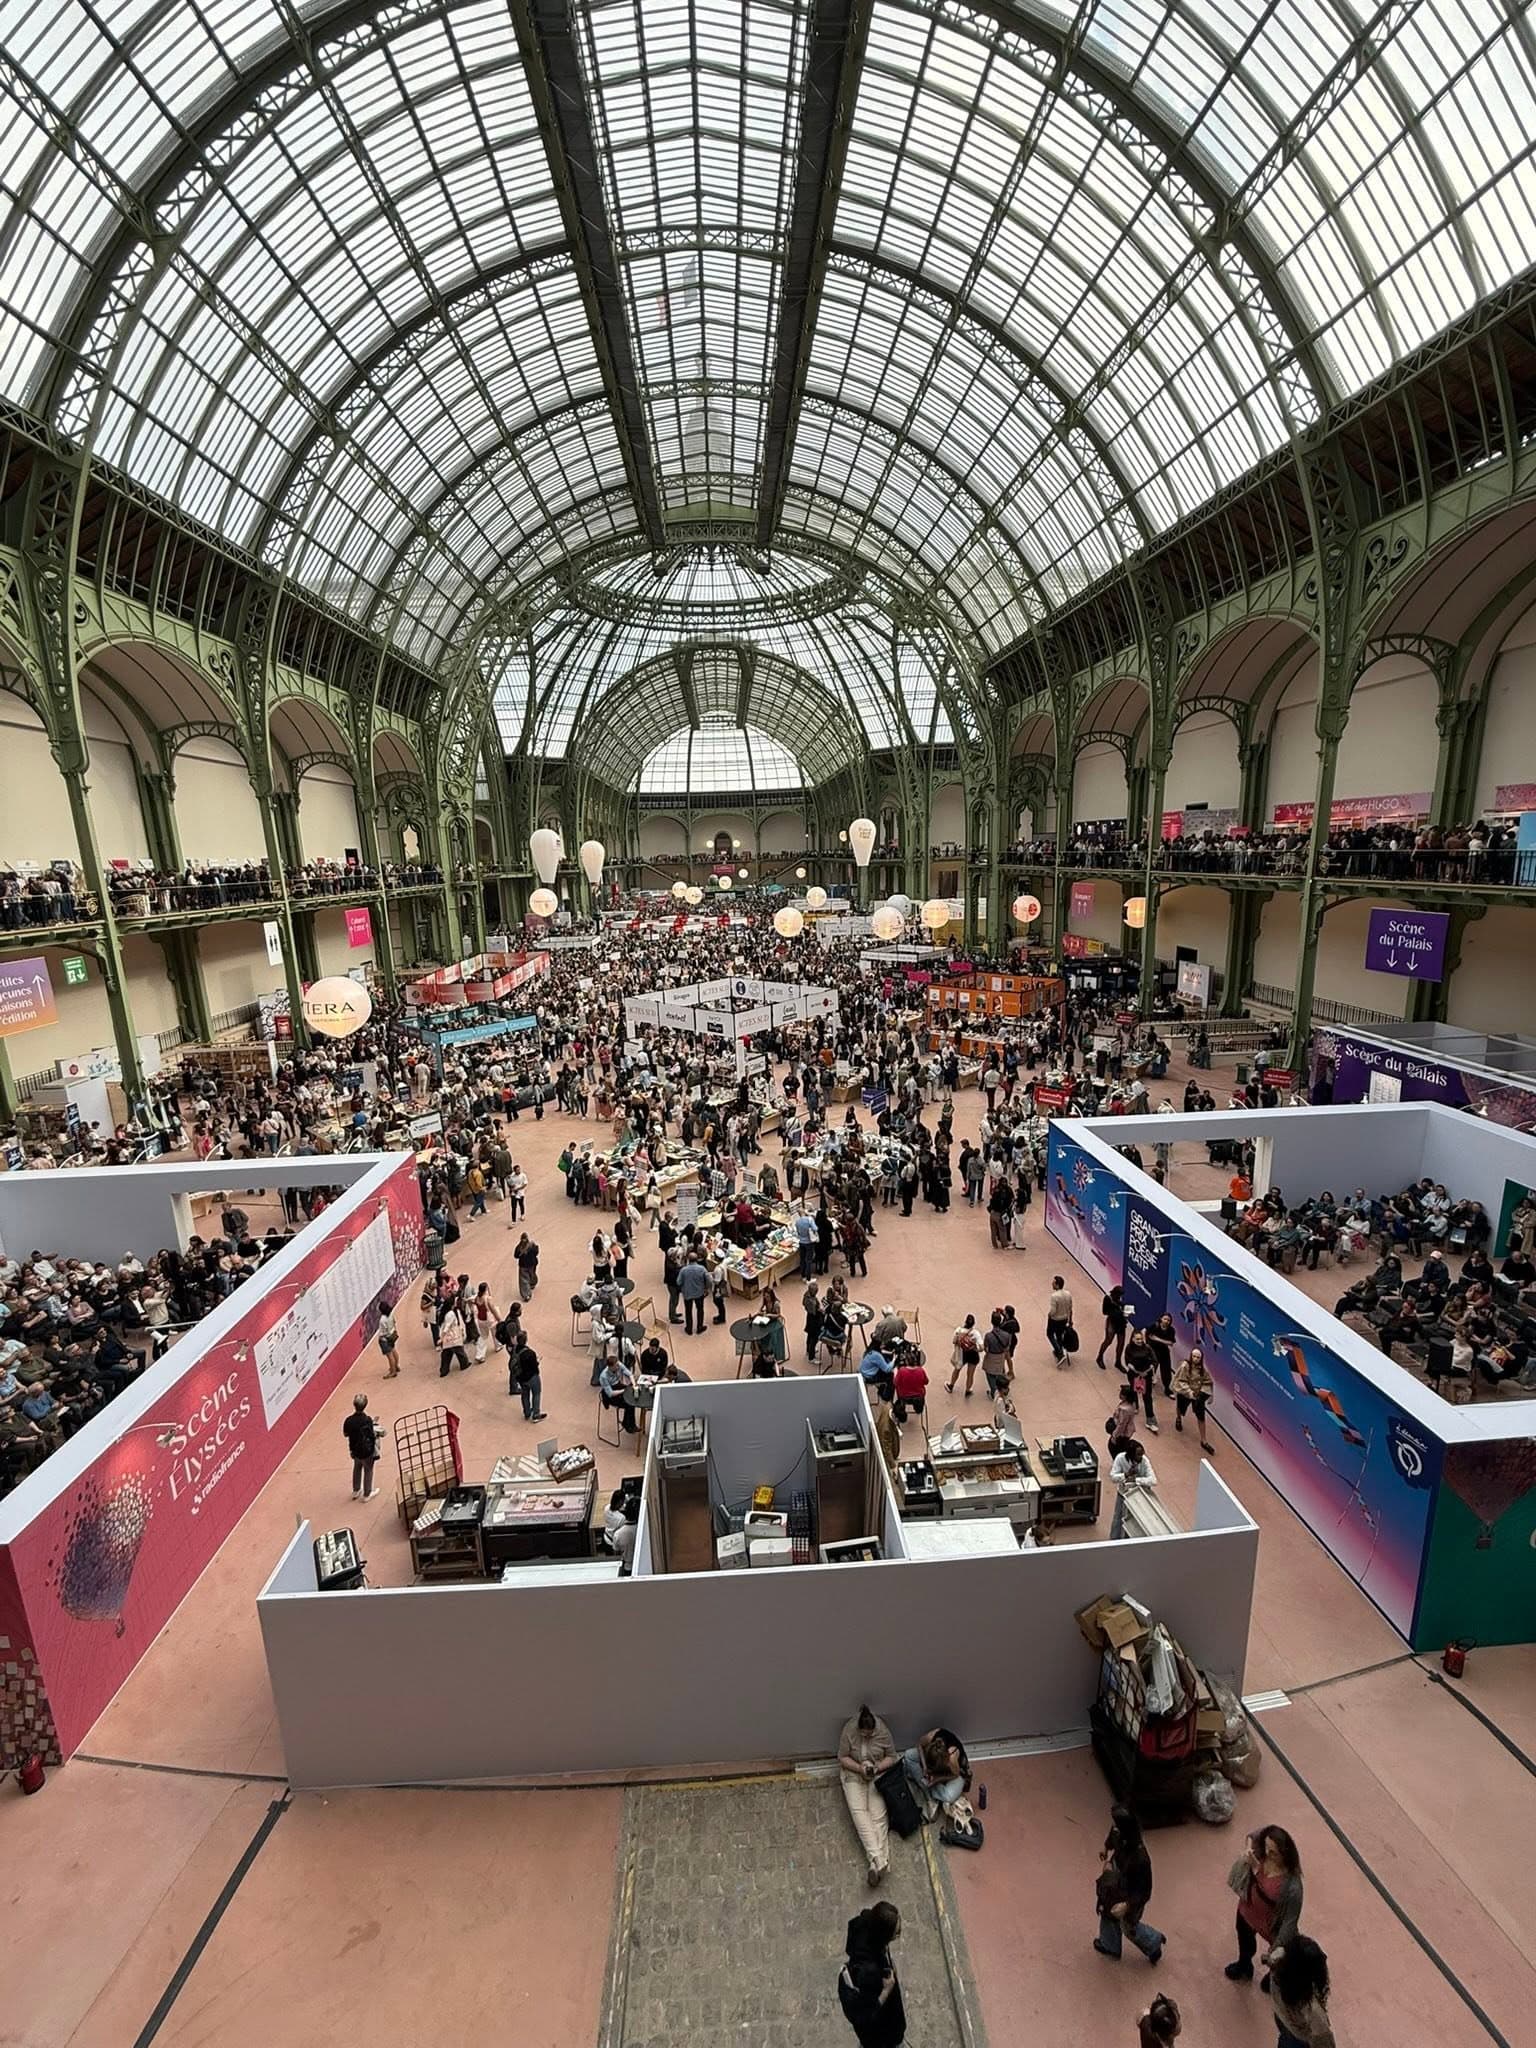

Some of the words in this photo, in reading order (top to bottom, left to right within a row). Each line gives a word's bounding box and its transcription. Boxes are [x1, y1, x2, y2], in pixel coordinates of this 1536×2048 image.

[1379, 933, 1394, 946] du
[1398, 935, 1433, 951] Palais
[1389, 920, 1425, 935] Scène
[1345, 1043, 1381, 1065] Scène
[1385, 1056, 1402, 1072] du
[1130, 1209, 1160, 1239] GRAND
[1130, 1221, 1148, 1246] PRIX
[1128, 1246, 1149, 1271] RATP
[169, 1372, 240, 1455] Scène
[169, 1396, 251, 1500] Élysées
[201, 1441, 246, 1498] radiofrance
